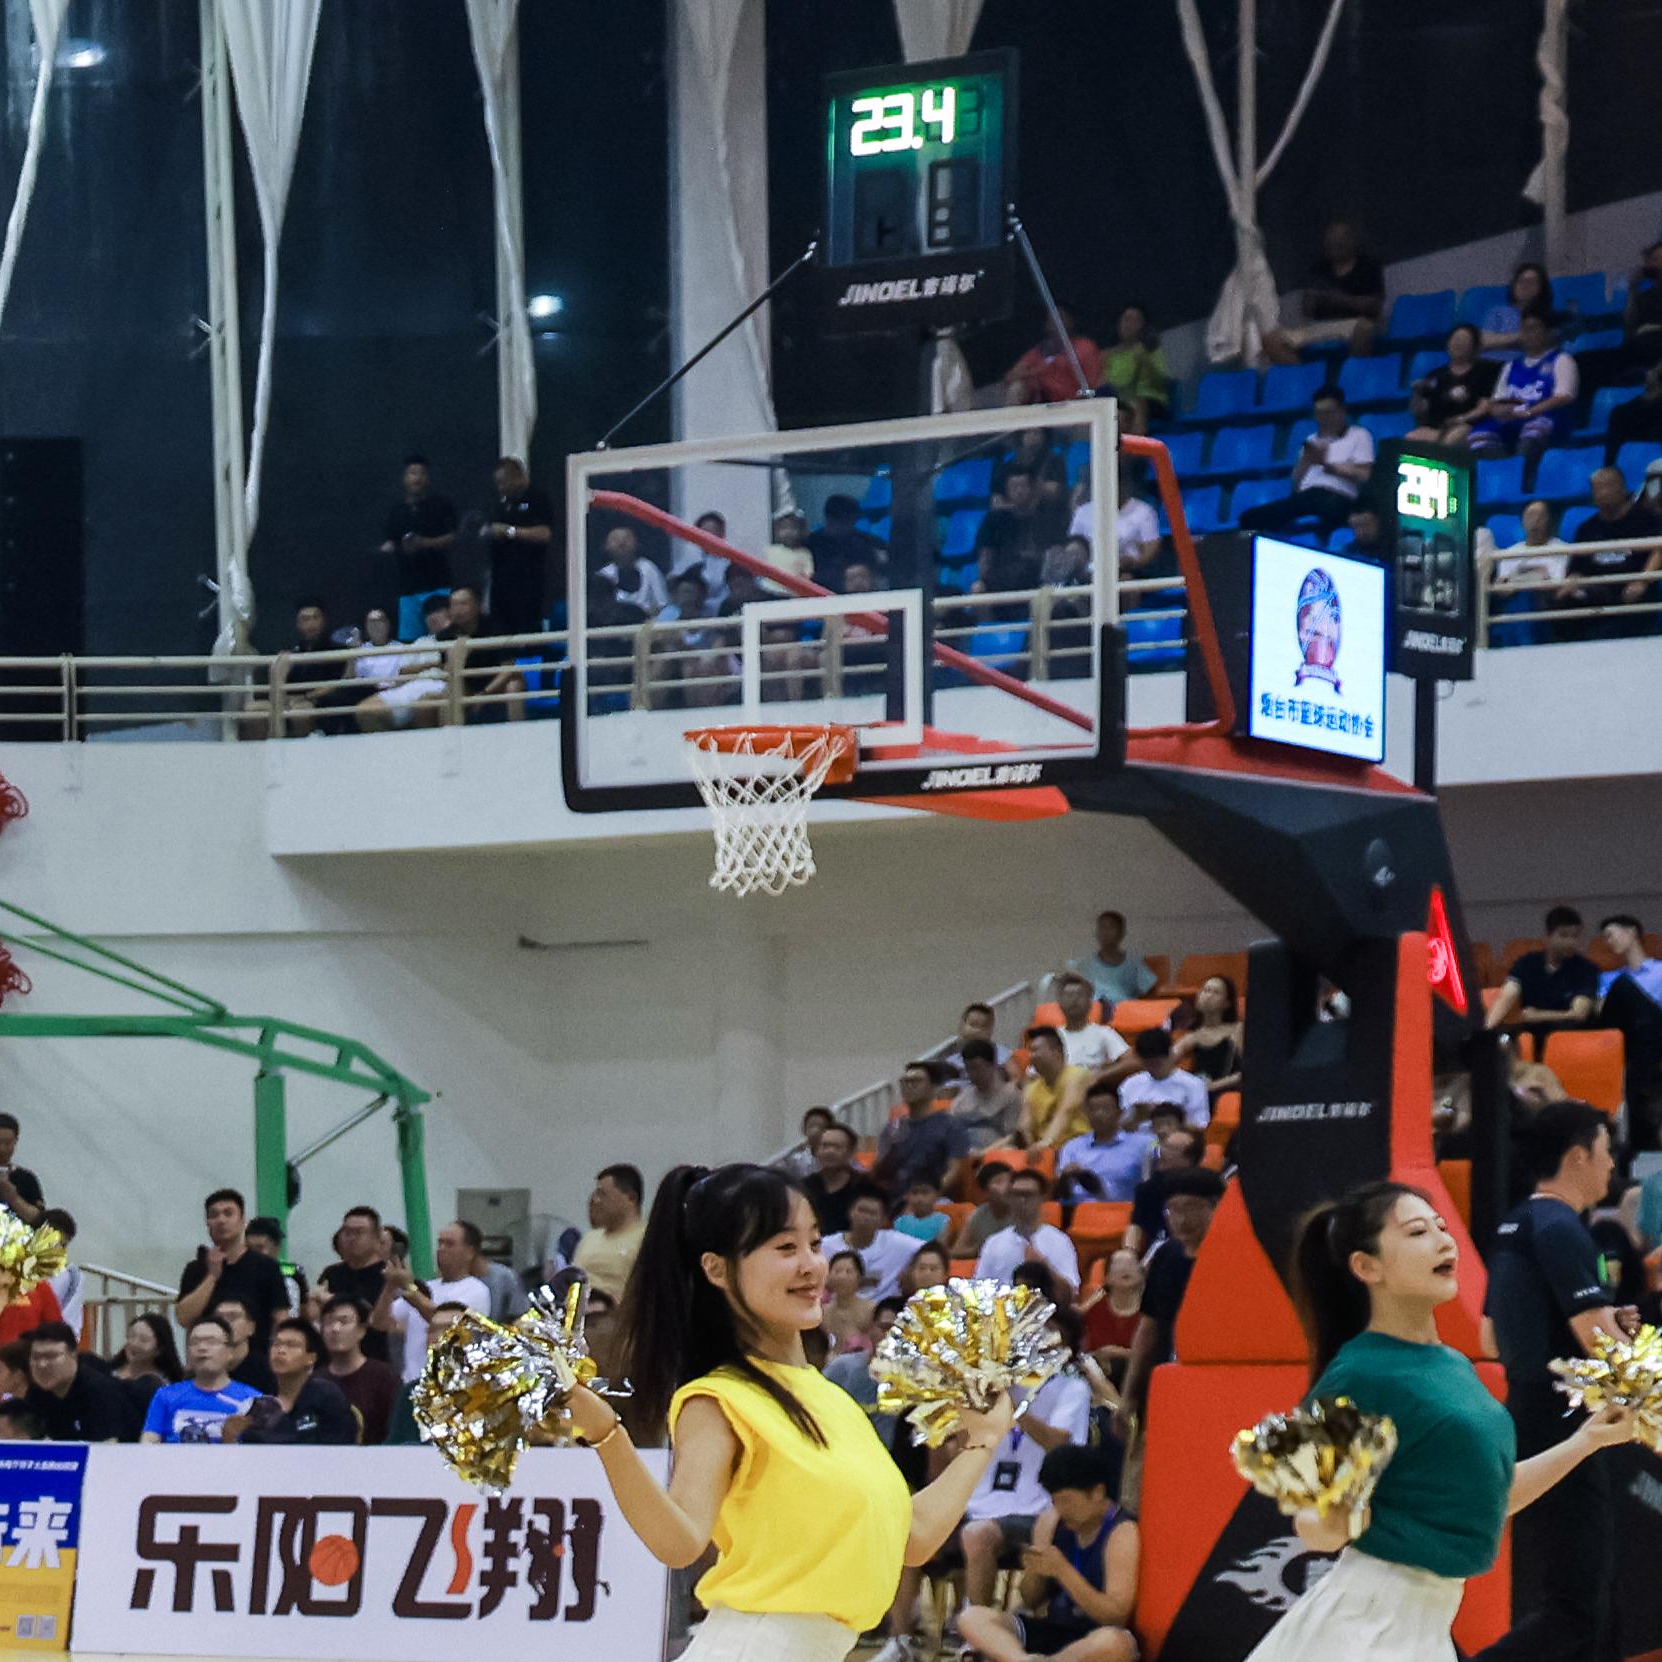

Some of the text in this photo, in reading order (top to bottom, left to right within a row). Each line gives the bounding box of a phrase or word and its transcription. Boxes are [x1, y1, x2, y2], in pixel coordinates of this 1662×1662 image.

[850, 86, 956, 157] 23.4
[129, 1493, 611, 1622] 乐阳飞翔
